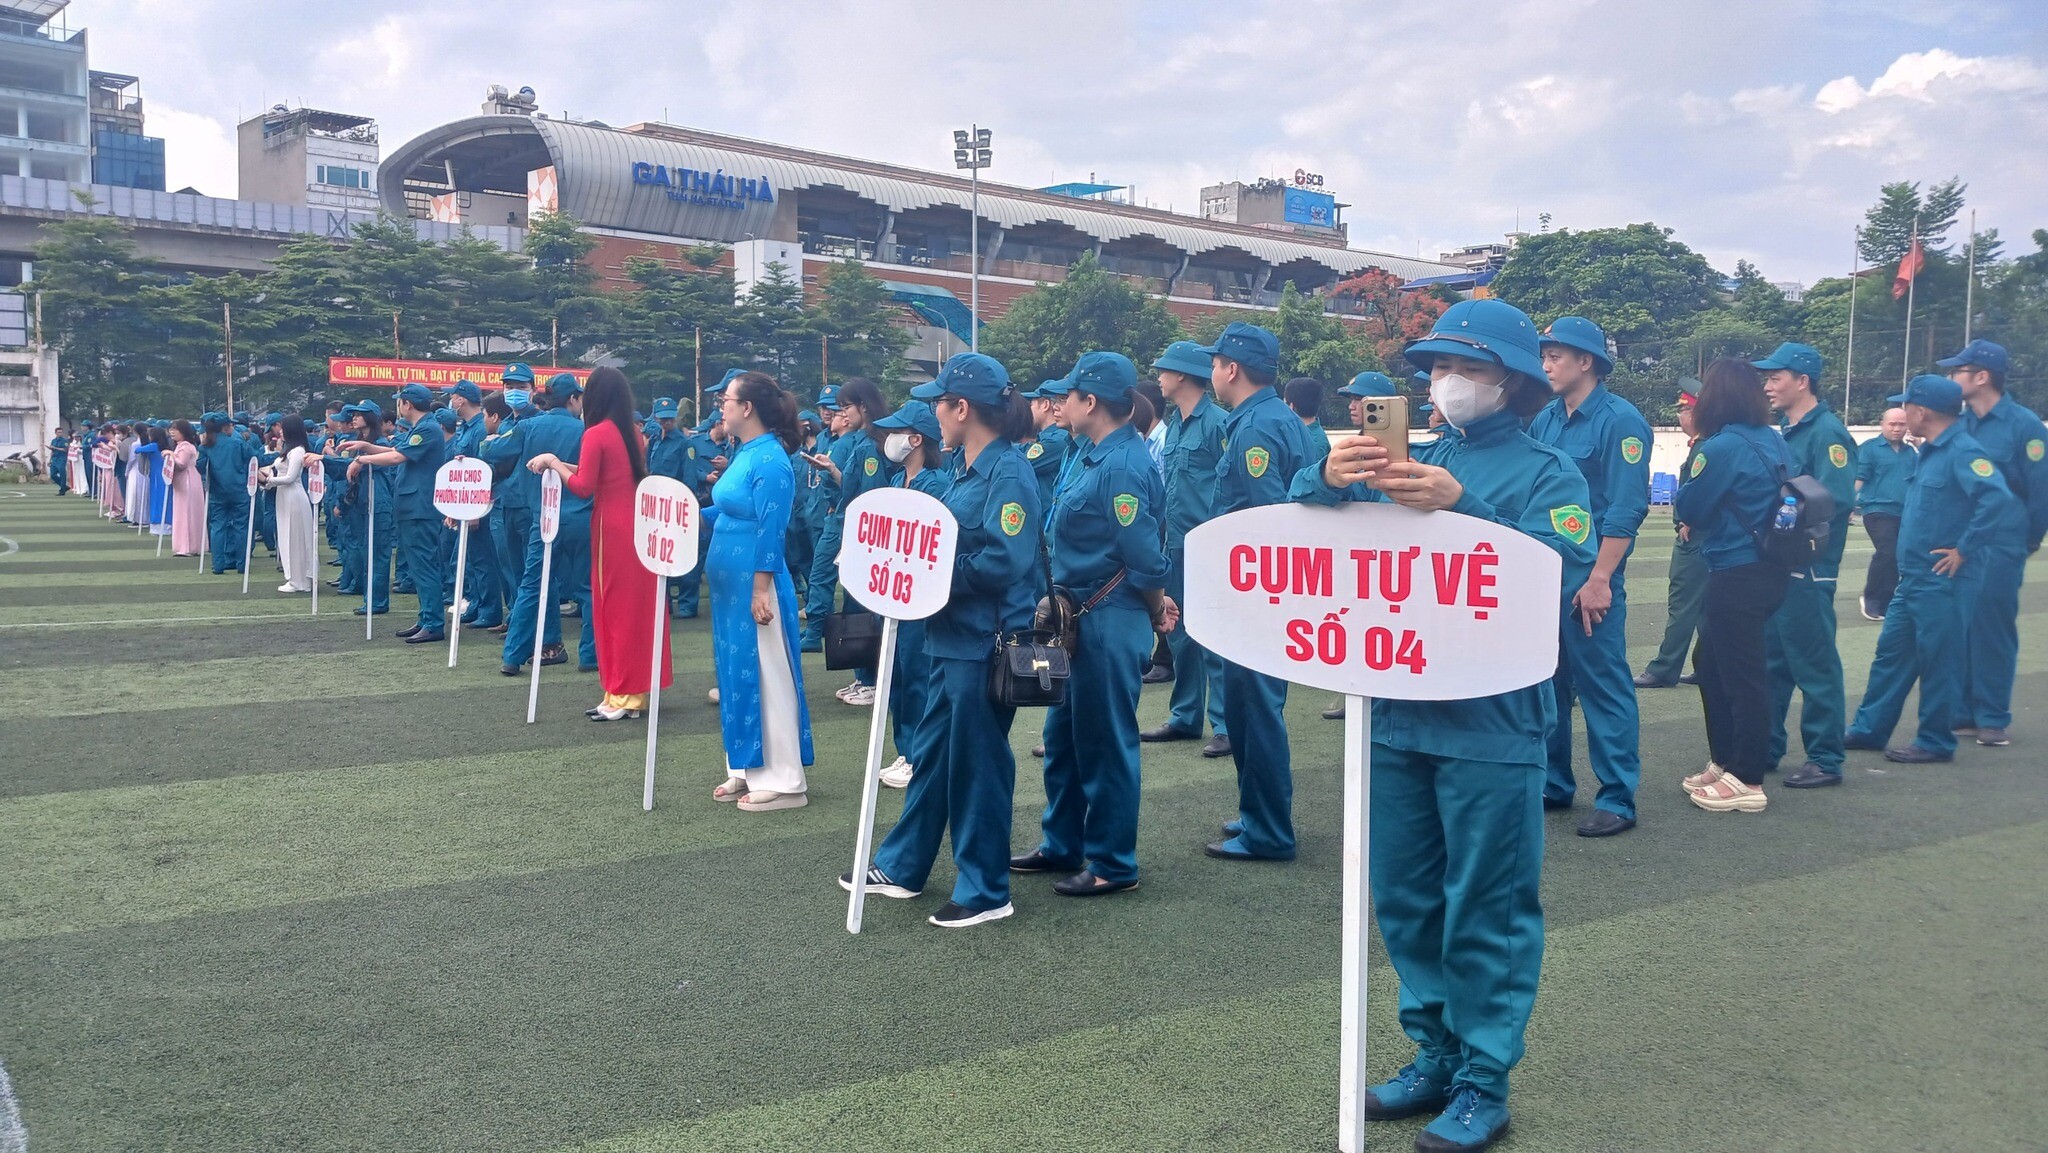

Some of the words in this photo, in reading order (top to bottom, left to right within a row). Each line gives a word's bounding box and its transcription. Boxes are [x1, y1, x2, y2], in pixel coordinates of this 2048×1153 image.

[632, 161, 671, 188] GA
[678, 168, 734, 197] THÁI
[740, 175, 774, 203] HÀ
[1306, 173, 1324, 186] SCB
[345, 364, 368, 378] BÌNH
[370, 365, 395, 380] TĨNH,
[397, 367, 410, 382] TỰ
[411, 368, 428, 381] TIN,
[430, 369, 448, 383] ĐẠT
[449, 368, 466, 382] KẾT
[449, 469, 463, 482] BAN
[464, 469, 482, 483] CHQS
[641, 492, 657, 522] CỤM
[659, 496, 673, 528] TỰ
[676, 497, 689, 533] VỆ
[647, 528, 658, 559] SỐ
[659, 537, 675, 564] 02
[857, 511, 893, 553] CỤM
[895, 519, 919, 563] TỰ
[919, 519, 942, 570] VỆ
[868, 557, 893, 596] SỐ
[892, 571, 913, 604] 03
[1229, 544, 1333, 605] CỤM
[1350, 545, 1421, 614] TỰ
[1431, 542, 1499, 620] VỆ
[1285, 607, 1350, 665] SỐ
[1365, 626, 1427, 675] 04
